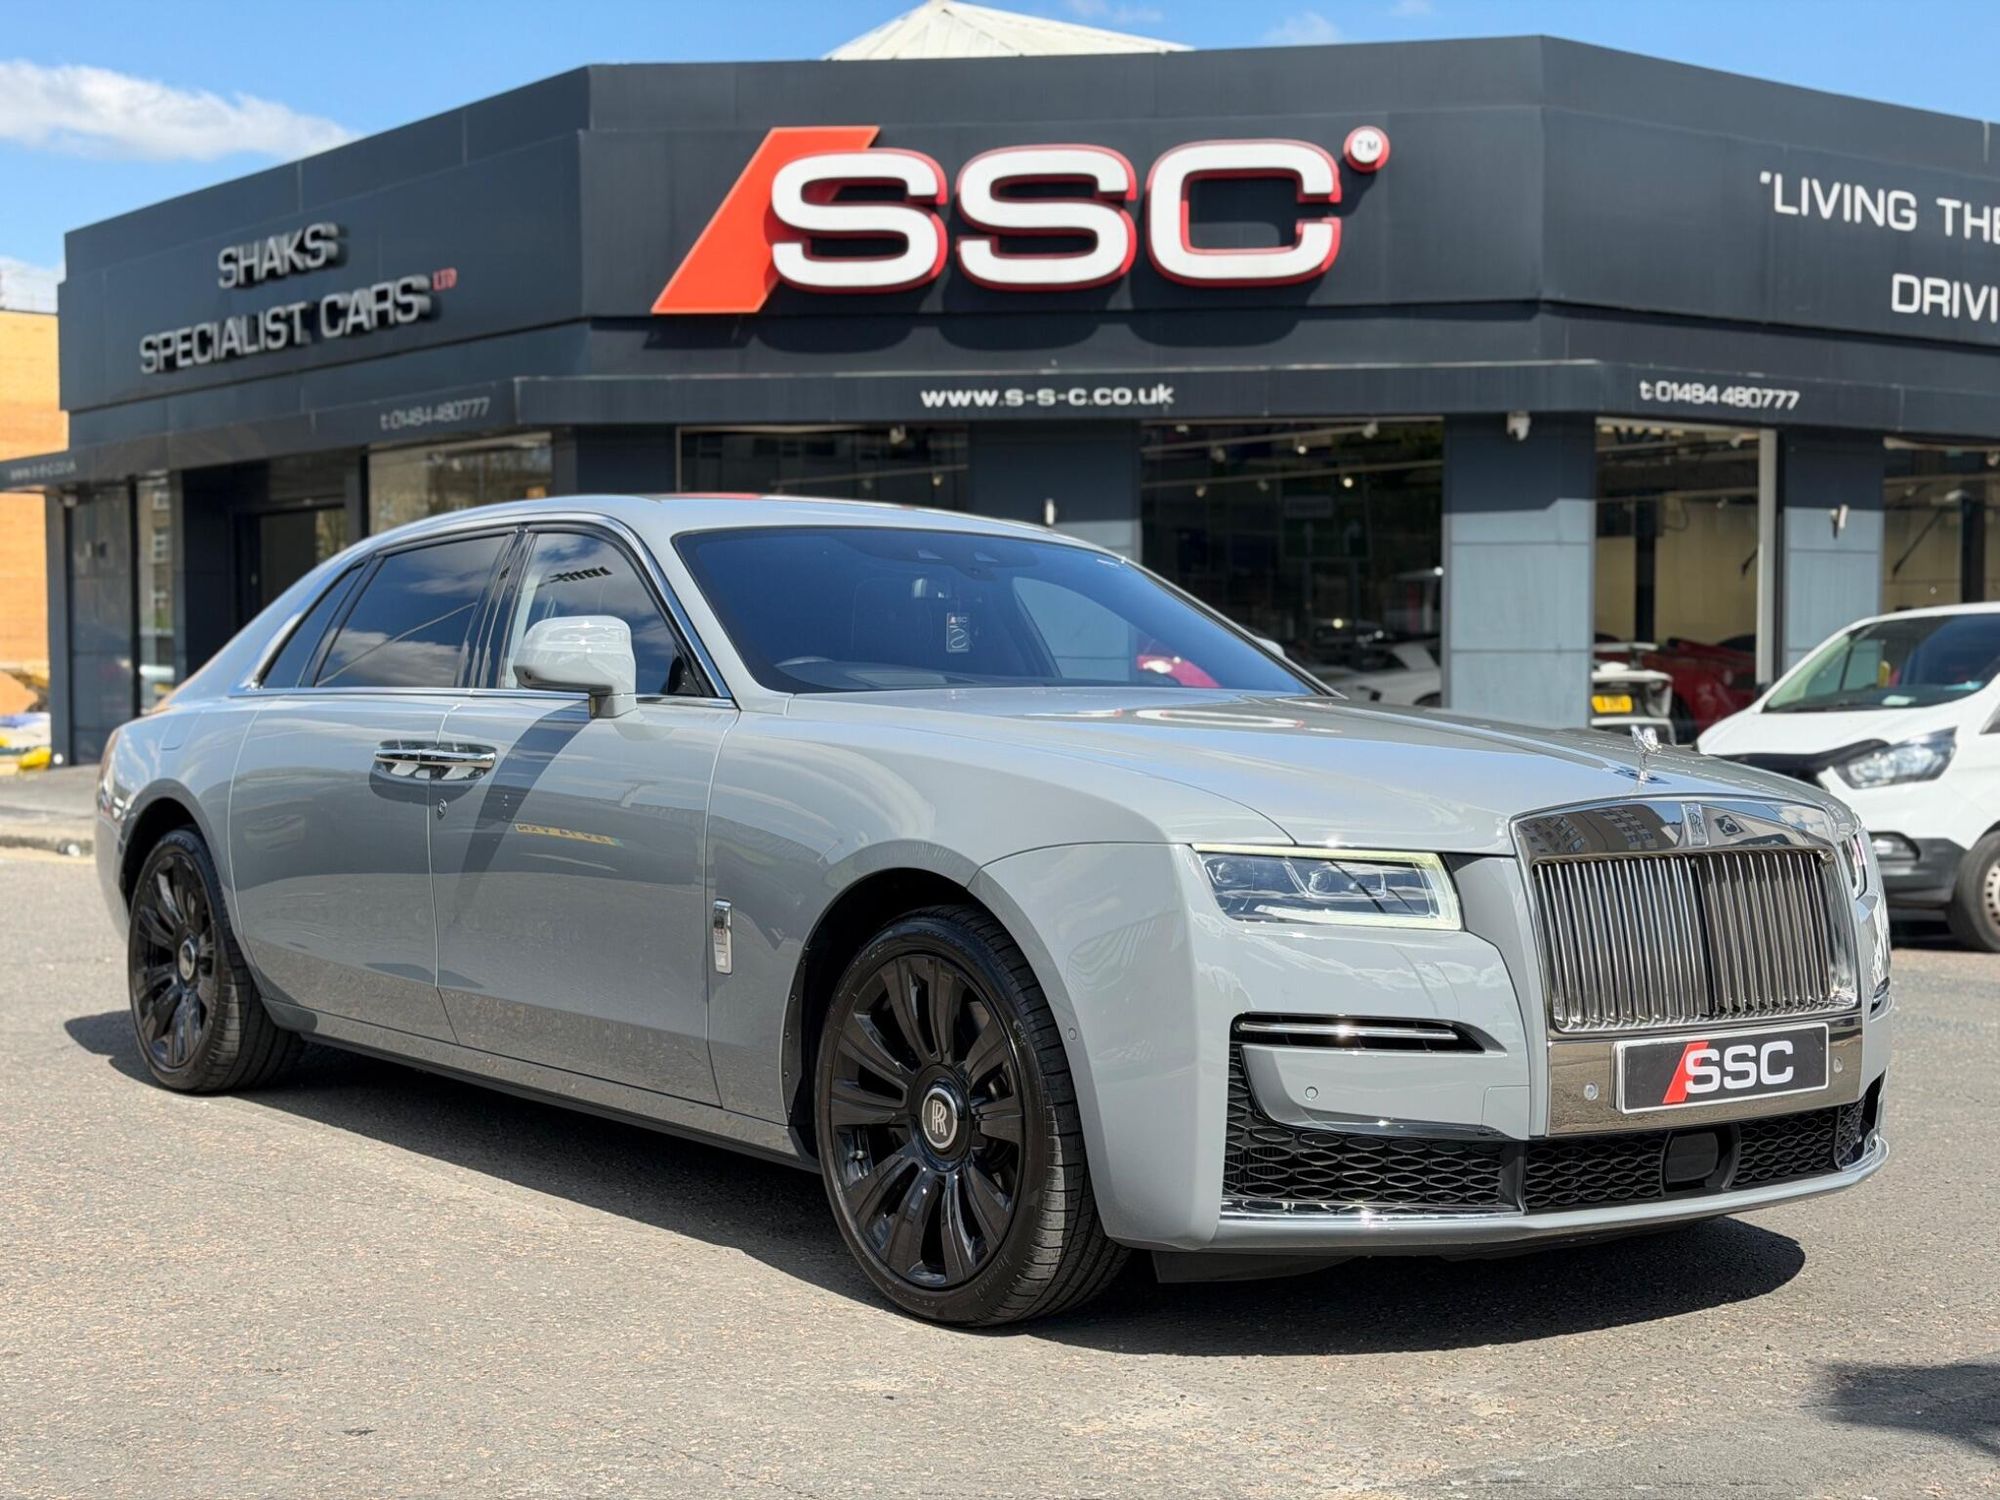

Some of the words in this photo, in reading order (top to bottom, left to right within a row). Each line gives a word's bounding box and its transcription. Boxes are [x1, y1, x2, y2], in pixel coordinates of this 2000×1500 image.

[1357, 140, 1377, 151] TM
[767, 140, 1342, 295] SSC
[217, 222, 340, 289] SHAKS
[433, 267, 457, 291] LTD
[139, 301, 313, 374] SPECIALIST
[319, 274, 432, 340] CARS
[921, 384, 1174, 408] www.s-s-c.co.uk
[1685, 1040, 1794, 1094] SSC
